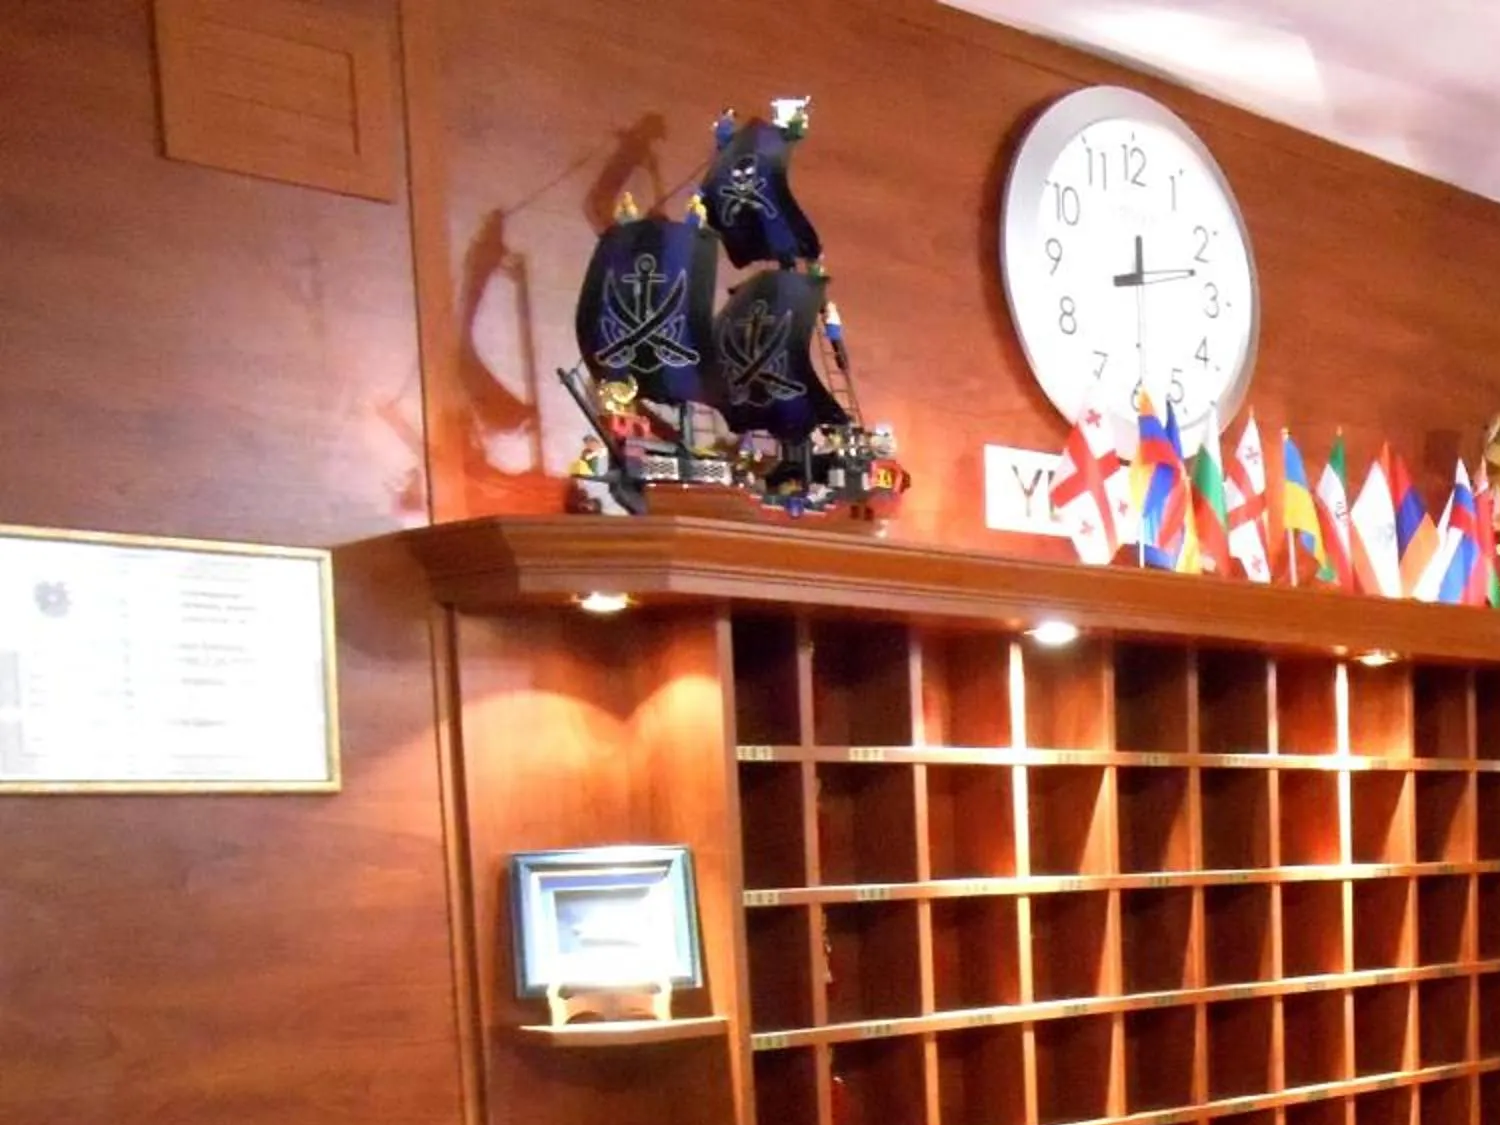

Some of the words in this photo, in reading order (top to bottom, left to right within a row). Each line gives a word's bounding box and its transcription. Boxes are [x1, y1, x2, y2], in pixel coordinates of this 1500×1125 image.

[1086, 147, 1107, 191] 11
[1121, 144, 1146, 187] 12
[1053, 182, 1080, 226] 10
[1168, 175, 1176, 211] 1
[1045, 238, 1062, 276] 9
[1193, 225, 1210, 263] 2
[1059, 295, 1077, 335] 8
[1204, 282, 1219, 319] 3
[1093, 350, 1109, 380] 7
[1194, 336, 1209, 370] 4
[1166, 367, 1185, 404] 5
